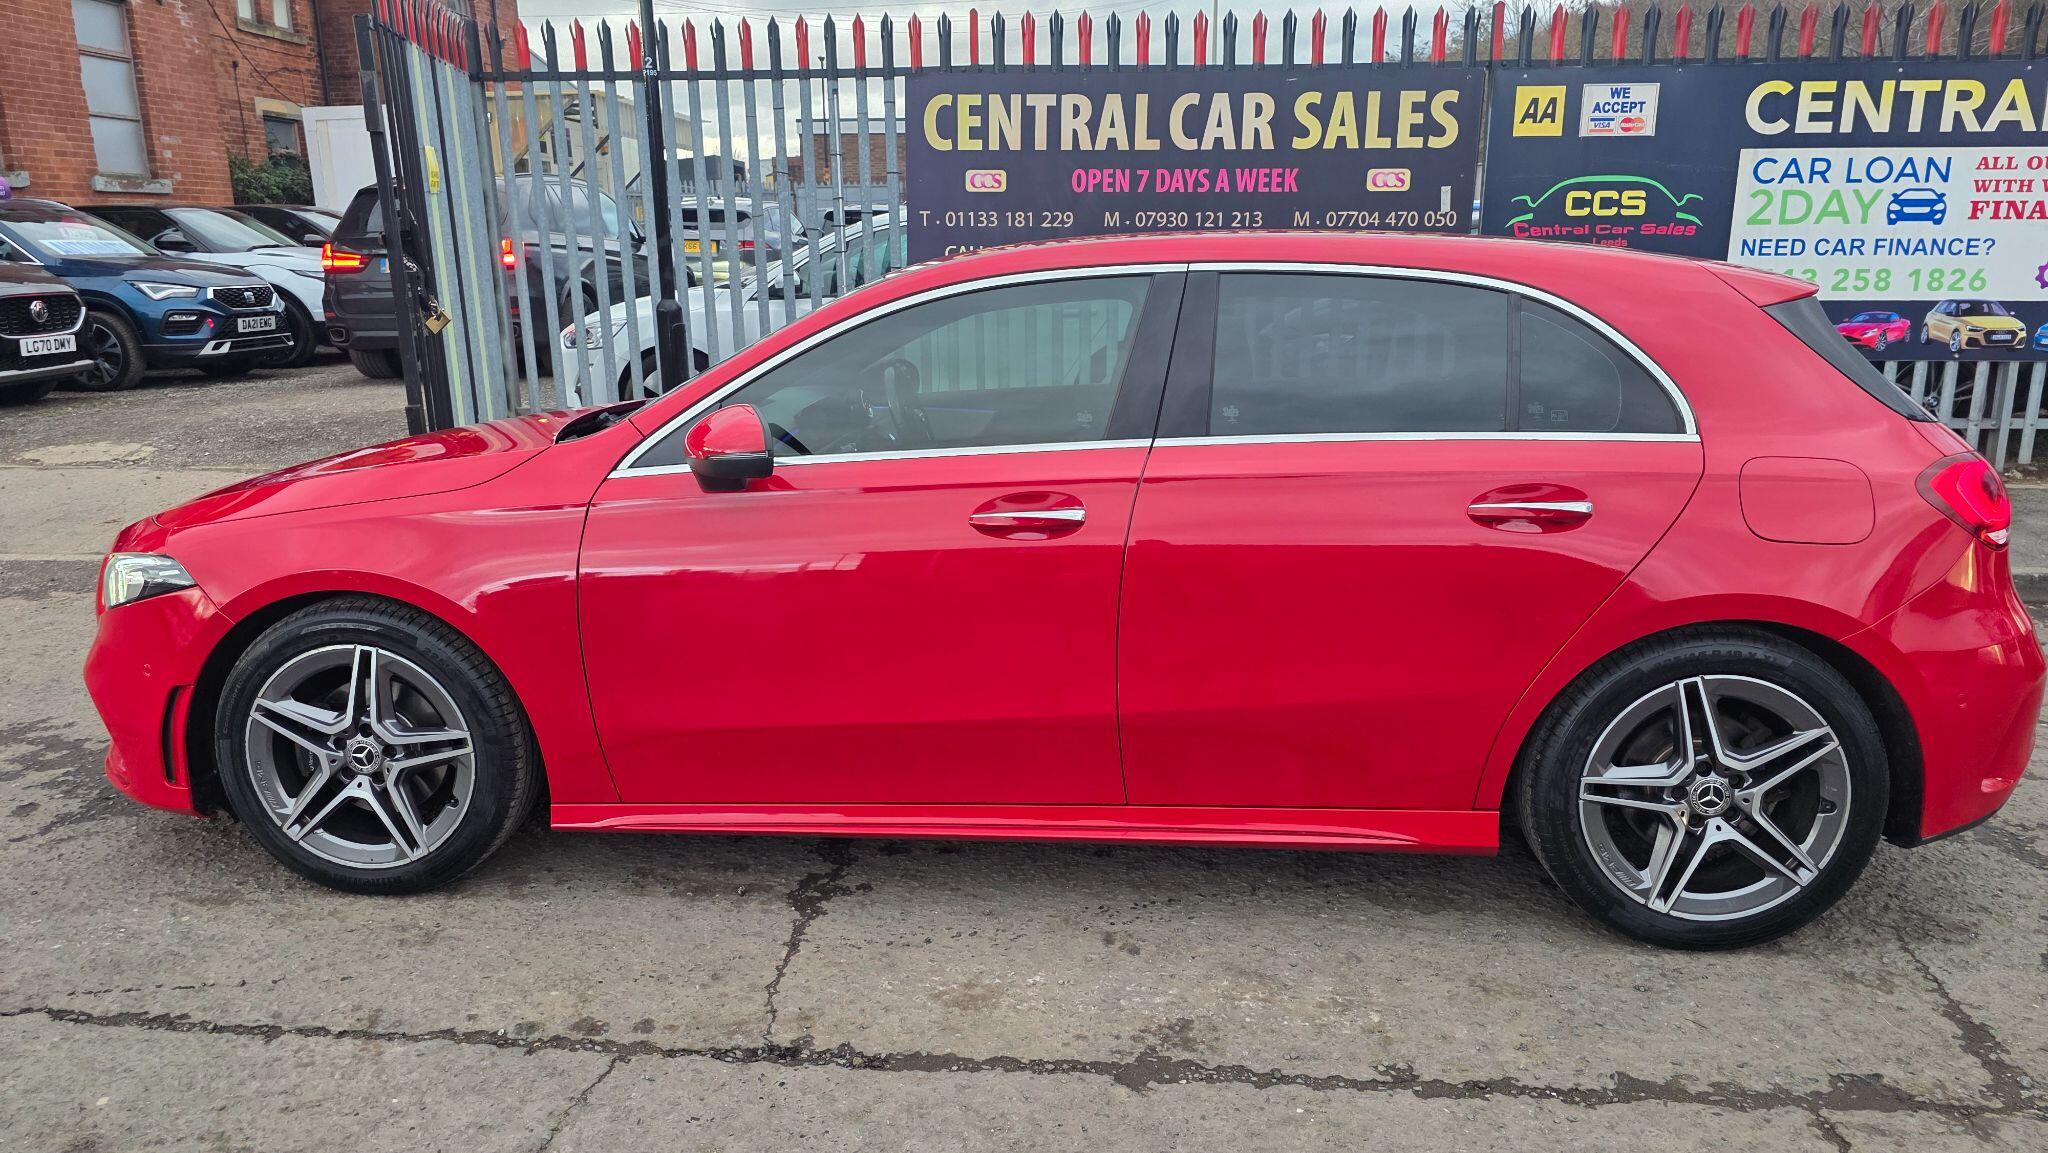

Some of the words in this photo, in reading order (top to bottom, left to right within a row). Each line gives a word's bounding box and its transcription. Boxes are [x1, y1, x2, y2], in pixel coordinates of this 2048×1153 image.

[645, 56, 653, 69] 2
[1610, 87, 1631, 99] WE
[1519, 97, 1558, 124] AA
[1592, 101, 1646, 114] ACCEPT
[1745, 78, 2048, 135] CENTRA
[923, 93, 1161, 151] CENTRAL
[1169, 92, 1275, 151] CAR
[1291, 89, 1460, 150] SALES
[1594, 121, 1611, 129] VISA
[1752, 157, 1832, 184] CAR
[1845, 156, 1953, 184] LOAN
[1975, 156, 2019, 170] ALL
[2027, 156, 2048, 170] O
[969, 173, 1003, 189] CCS
[1071, 168, 1130, 193] OPEN
[1137, 169, 1150, 193] 7
[1156, 168, 1210, 193] DAYS
[1215, 168, 1229, 193] A
[1235, 167, 1299, 193] WEEK
[1371, 172, 1406, 189] CCS
[1974, 179, 2035, 193] WITH
[1565, 190, 1647, 217] CCS
[1746, 188, 1884, 225] 2DAY
[945, 211, 998, 227] 01133
[1005, 211, 1033, 227] 181
[1040, 211, 1074, 228] 229
[1135, 211, 1188, 227] 07930
[1195, 211, 1223, 227] 121
[1231, 211, 1263, 227] 213
[1325, 211, 1380, 227] 07704
[1385, 211, 1419, 227] 470
[1424, 210, 1457, 227] 050
[1513, 222, 1590, 238] Central
[1595, 224, 1634, 235] Car
[1640, 222, 1697, 236] Sales
[1740, 238, 1806, 256] NEED
[1814, 238, 1865, 256] CAR
[1873, 238, 1996, 256] FINANCE?
[1831, 268, 1892, 292] 258
[1908, 267, 1987, 292] 1826
[242, 318, 258, 330] DA21
[26, 339, 52, 353] LG70
[54, 337, 71, 350] DMY
